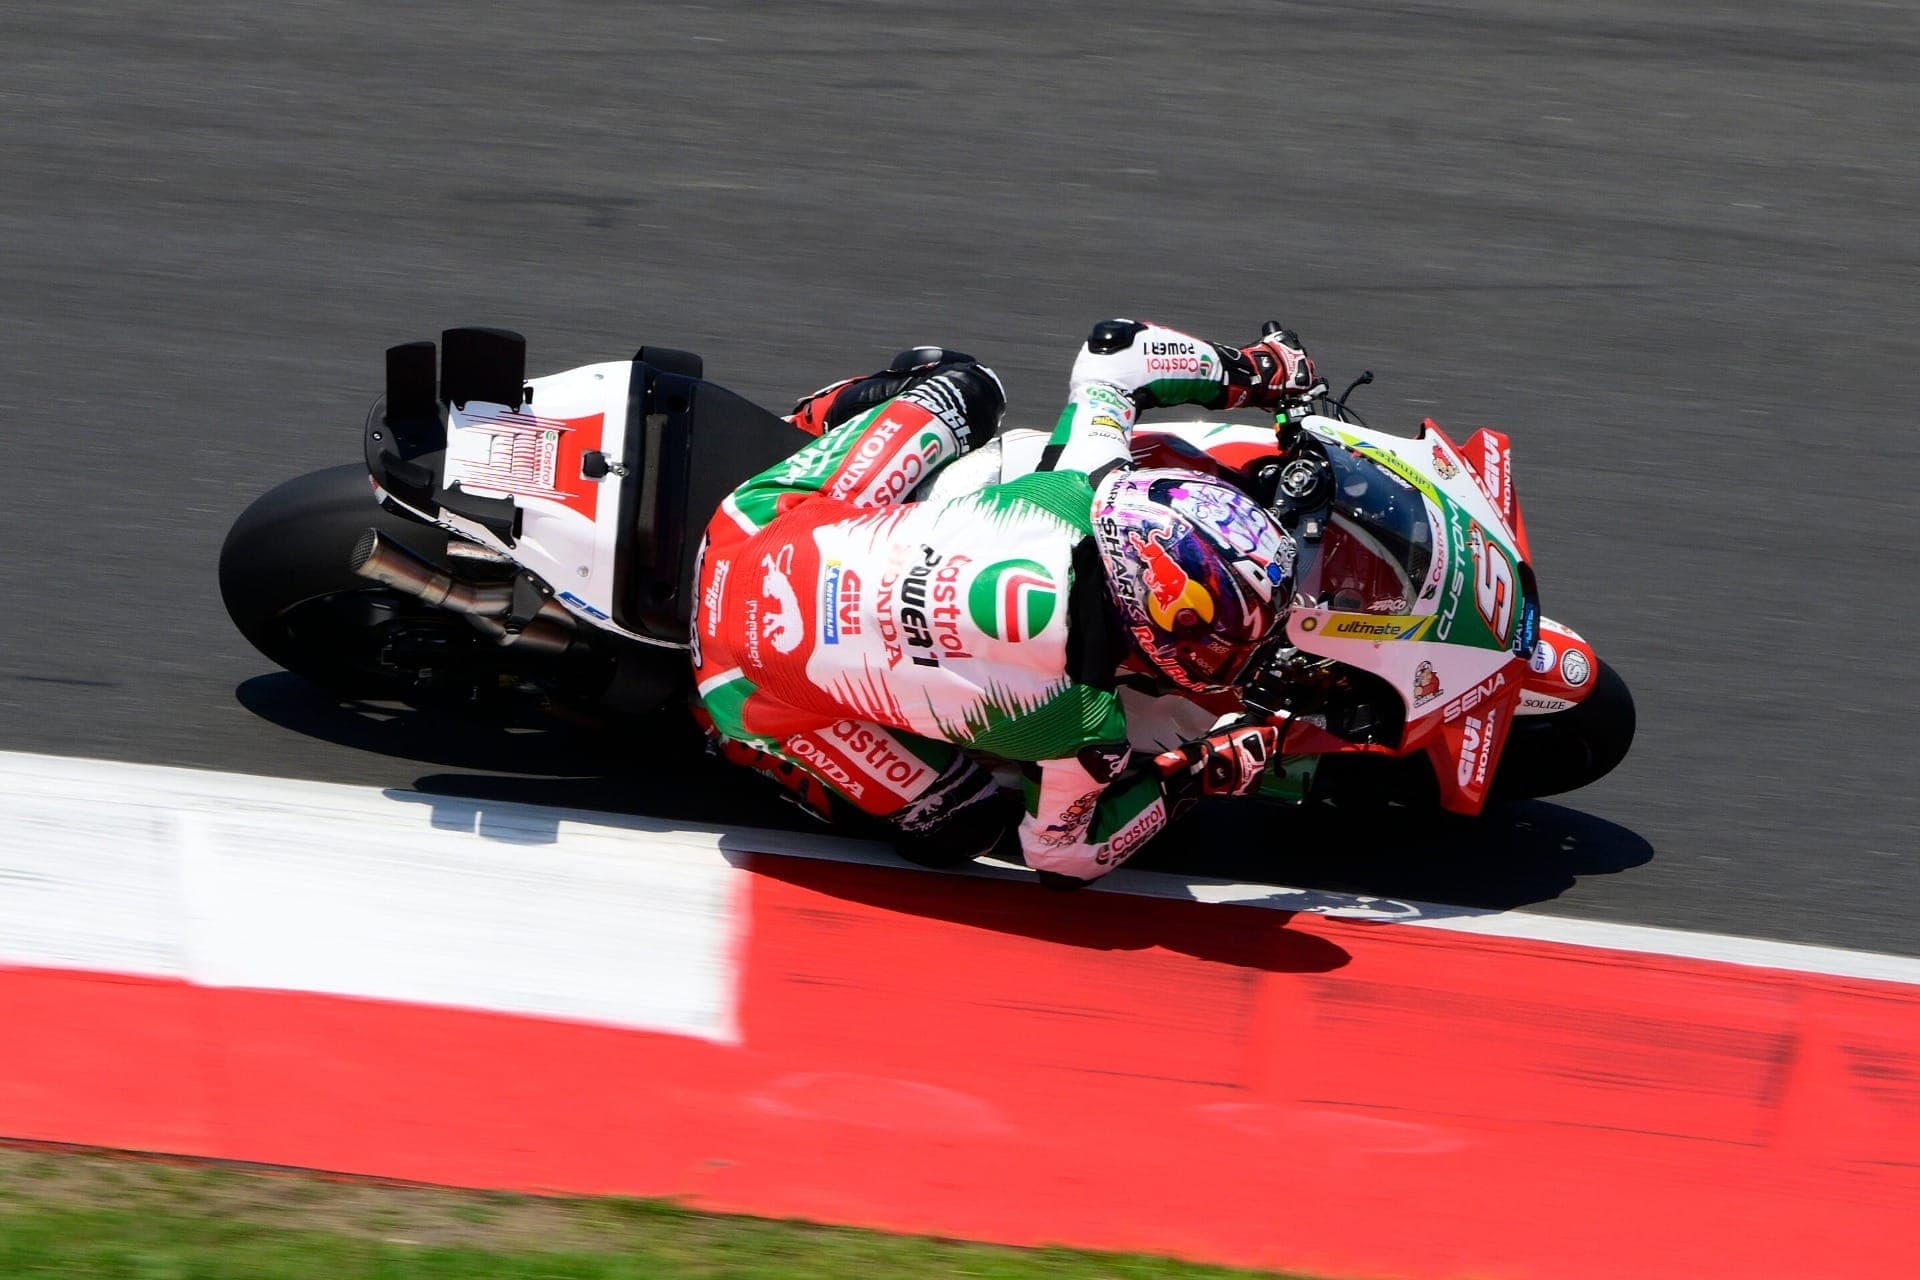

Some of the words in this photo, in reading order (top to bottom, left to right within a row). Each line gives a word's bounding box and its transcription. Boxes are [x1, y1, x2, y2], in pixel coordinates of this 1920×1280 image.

[1147, 358, 1198, 373] Castrol
[541, 443, 555, 487] Castrol
[830, 418, 903, 500] HONDA
[864, 454, 922, 507] Cas
[1483, 431, 1500, 498] GIVI
[1503, 448, 1513, 515] HONDA
[839, 568, 862, 635] GIVI
[1101, 517, 1151, 623] SHARK
[1437, 498, 1465, 641] CUSTOM
[1470, 521, 1515, 646] 5
[825, 581, 834, 638] MICHELIN
[876, 556, 905, 671] ONDA
[933, 554, 973, 658] Castrol
[1336, 616, 1401, 635] ultimate
[1131, 626, 1177, 667] Red
[1443, 672, 1506, 723] SENA
[1523, 699, 1566, 710] SOLIZE
[832, 719, 925, 789] astrol
[1457, 716, 1482, 787] GIVI
[1475, 710, 1497, 785] HONDA
[1110, 805, 1163, 853] Castrol
